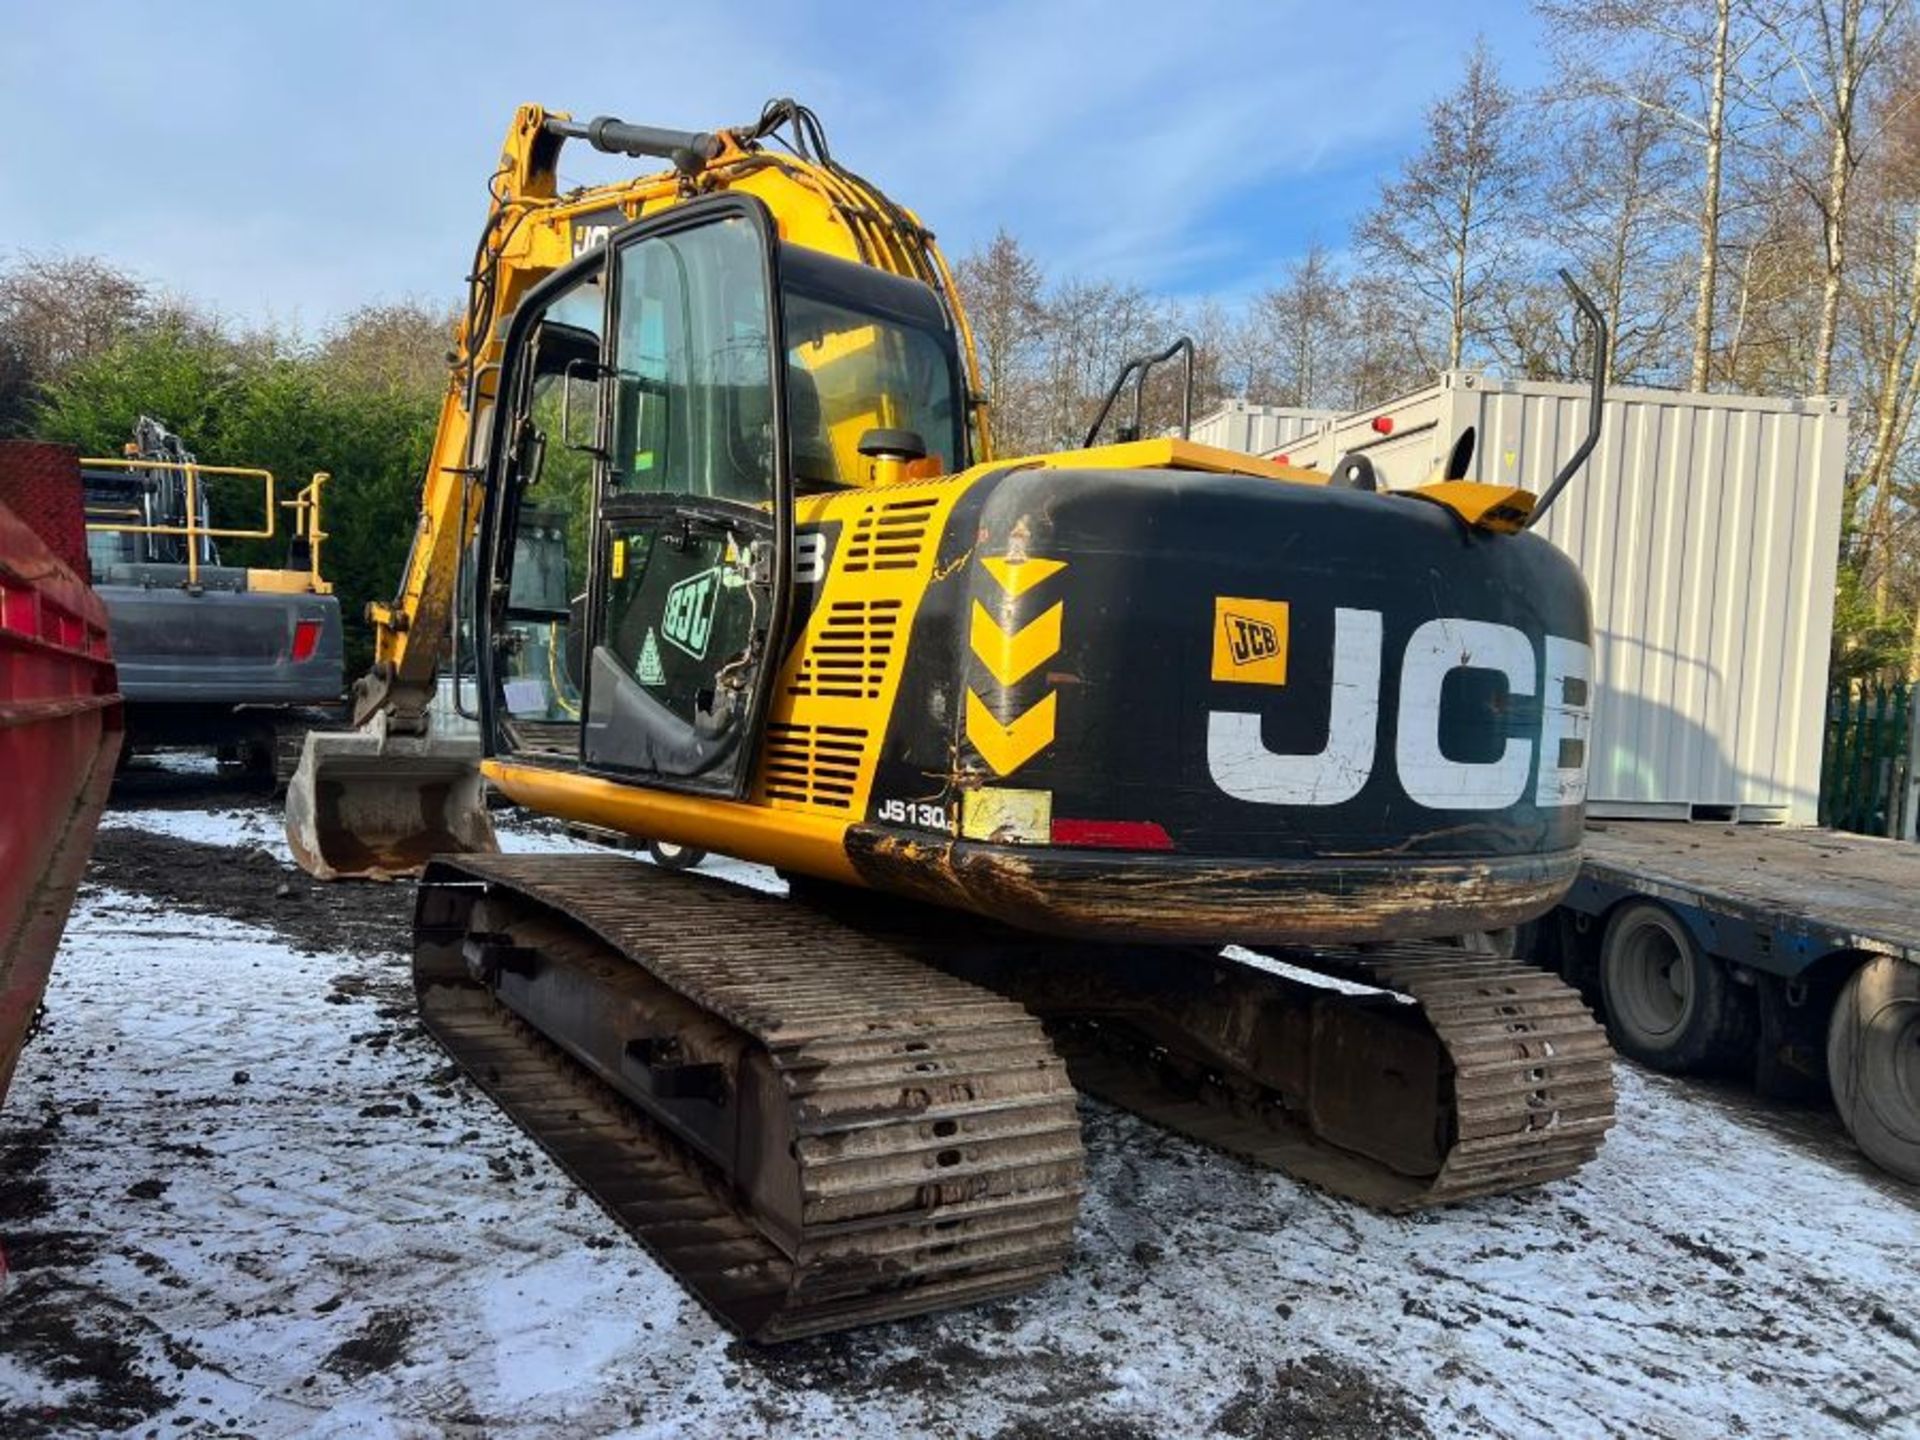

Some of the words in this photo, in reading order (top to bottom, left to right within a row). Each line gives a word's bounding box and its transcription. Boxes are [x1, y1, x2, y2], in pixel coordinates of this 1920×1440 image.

[1234, 619, 1276, 660] JCB
[1207, 607, 1591, 809] JCB
[878, 799, 945, 829] JS130
